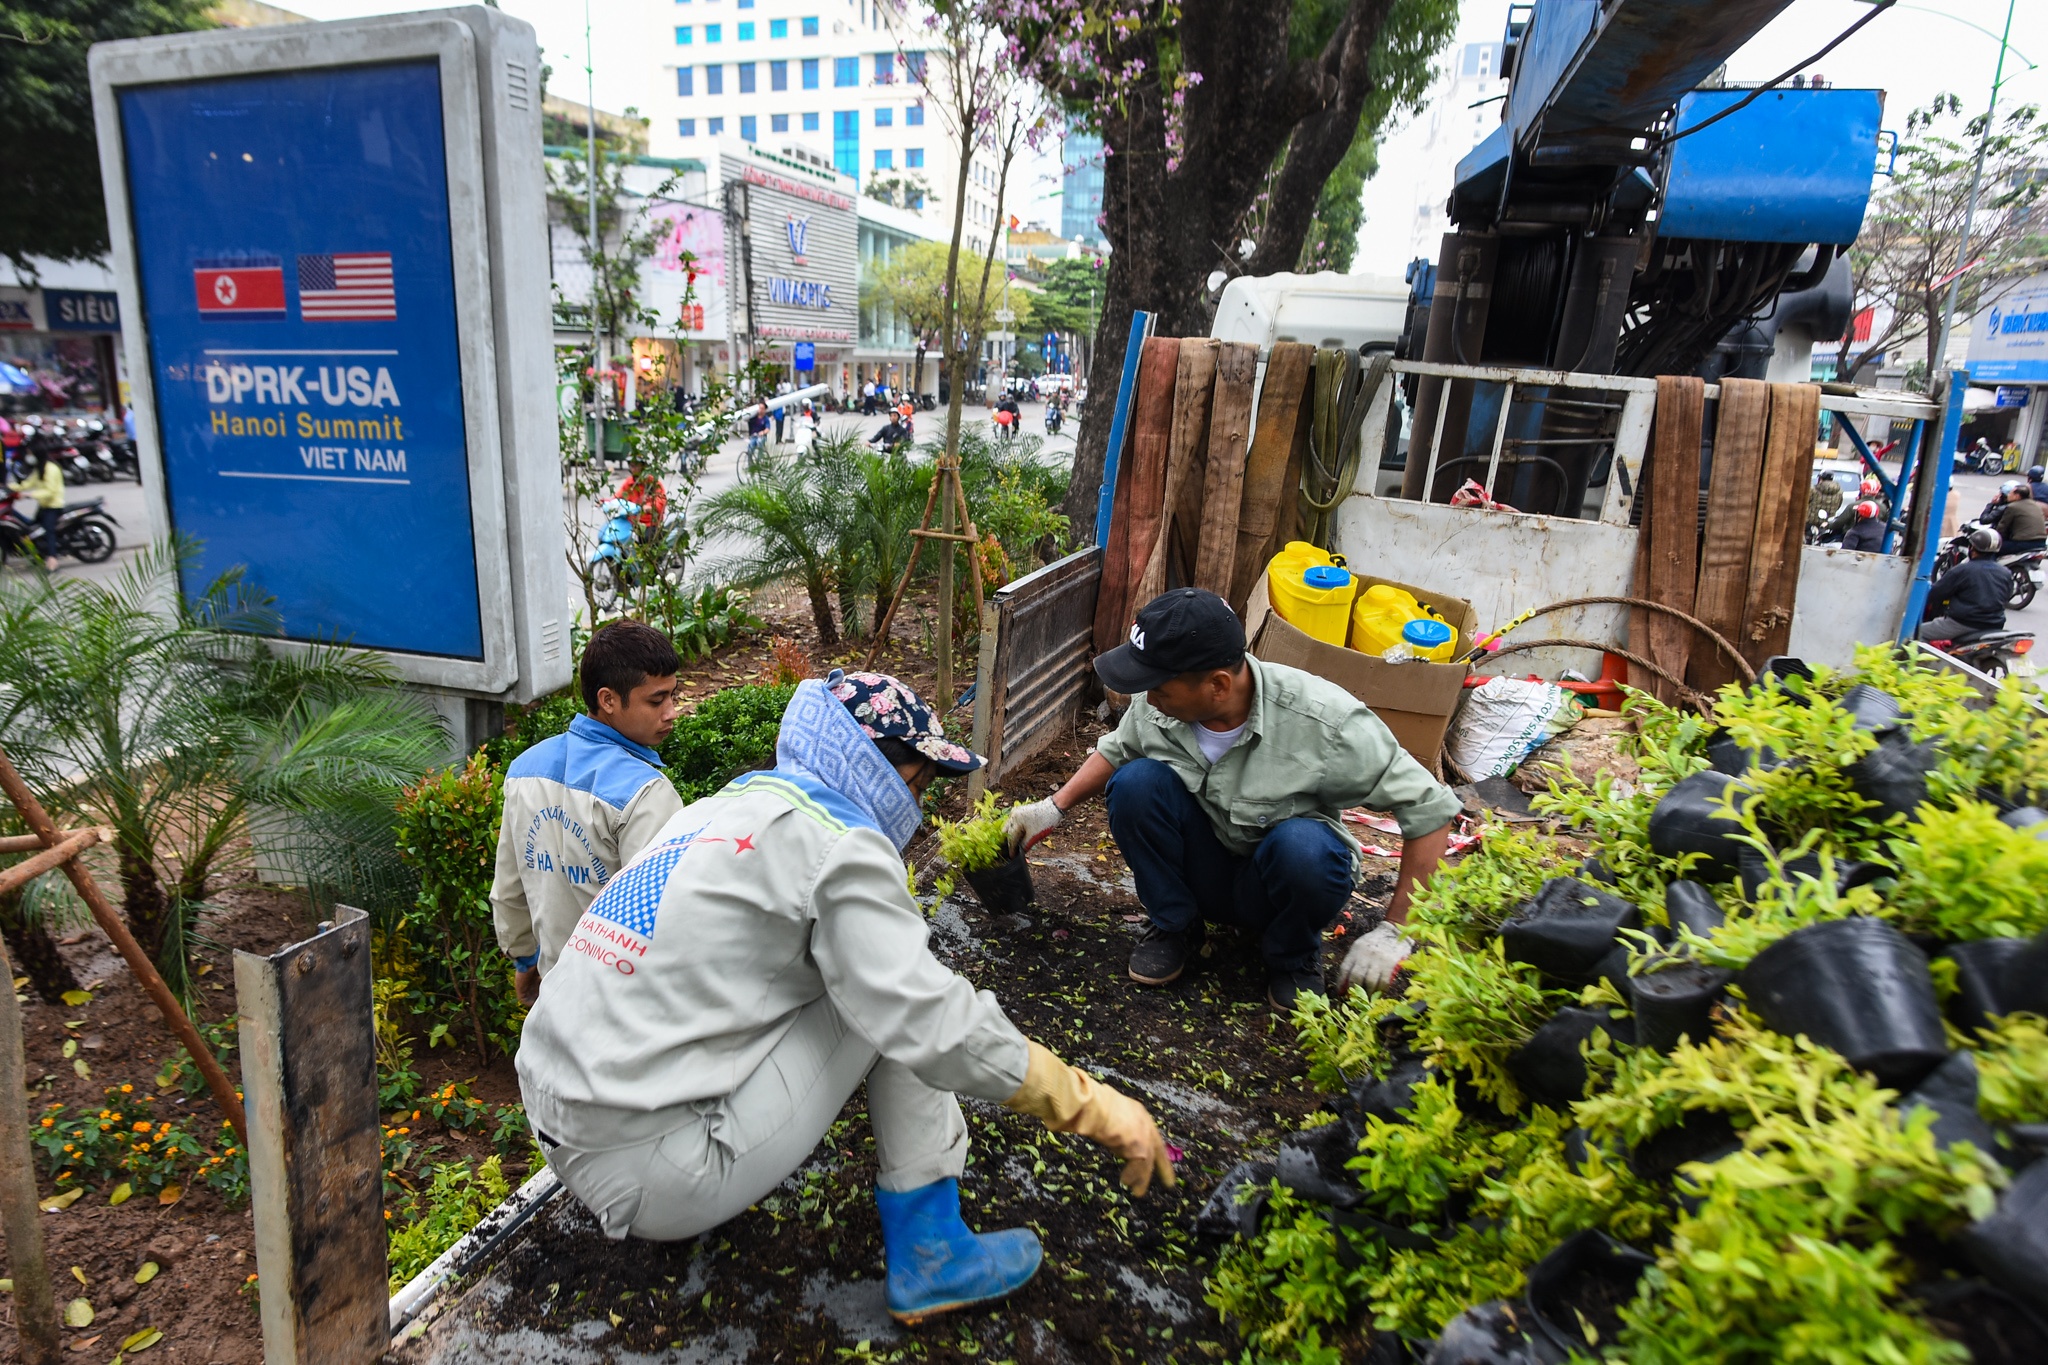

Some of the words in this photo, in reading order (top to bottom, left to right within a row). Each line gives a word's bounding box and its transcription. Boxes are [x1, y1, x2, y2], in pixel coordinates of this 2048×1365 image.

[60, 293, 117, 324] SIÊU
[206, 366, 401, 408] DPRK-USA
[210, 409, 287, 437] Hanoi
[297, 412, 404, 440] Summit
[299, 446, 348, 470] VIET
[354, 449, 407, 472] NAM
[537, 850, 554, 873] HÀ
[579, 918, 648, 958] HATHANH
[567, 935, 635, 976] CONINCO
